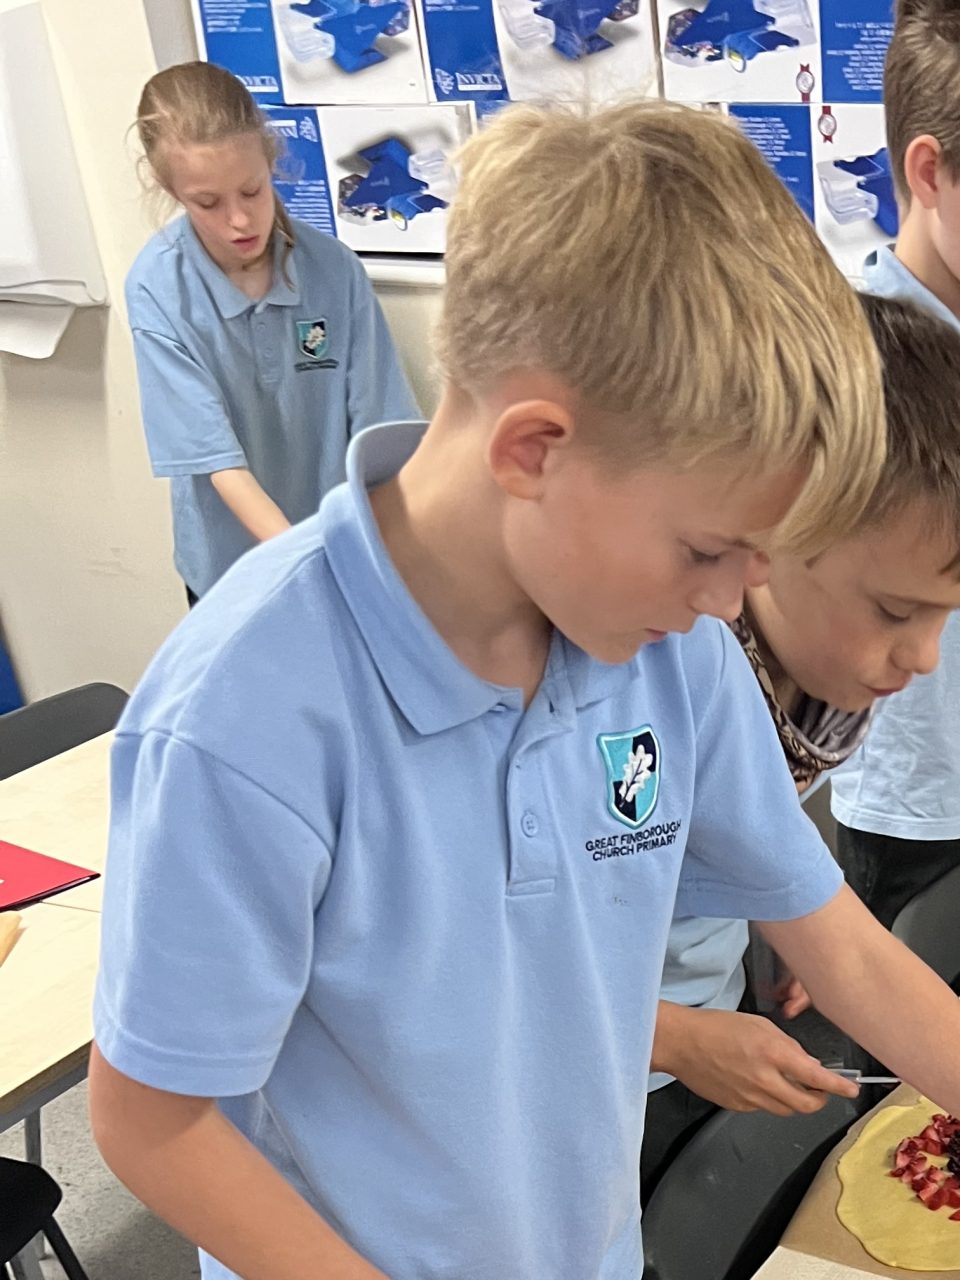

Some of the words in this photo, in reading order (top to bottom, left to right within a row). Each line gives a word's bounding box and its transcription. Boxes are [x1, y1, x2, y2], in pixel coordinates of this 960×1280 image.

[585, 835, 619, 851] GREAT
[620, 819, 682, 845] FINBOROUGH
[592, 844, 634, 861] CHURCH
[636, 834, 677, 853] PRIMARY
